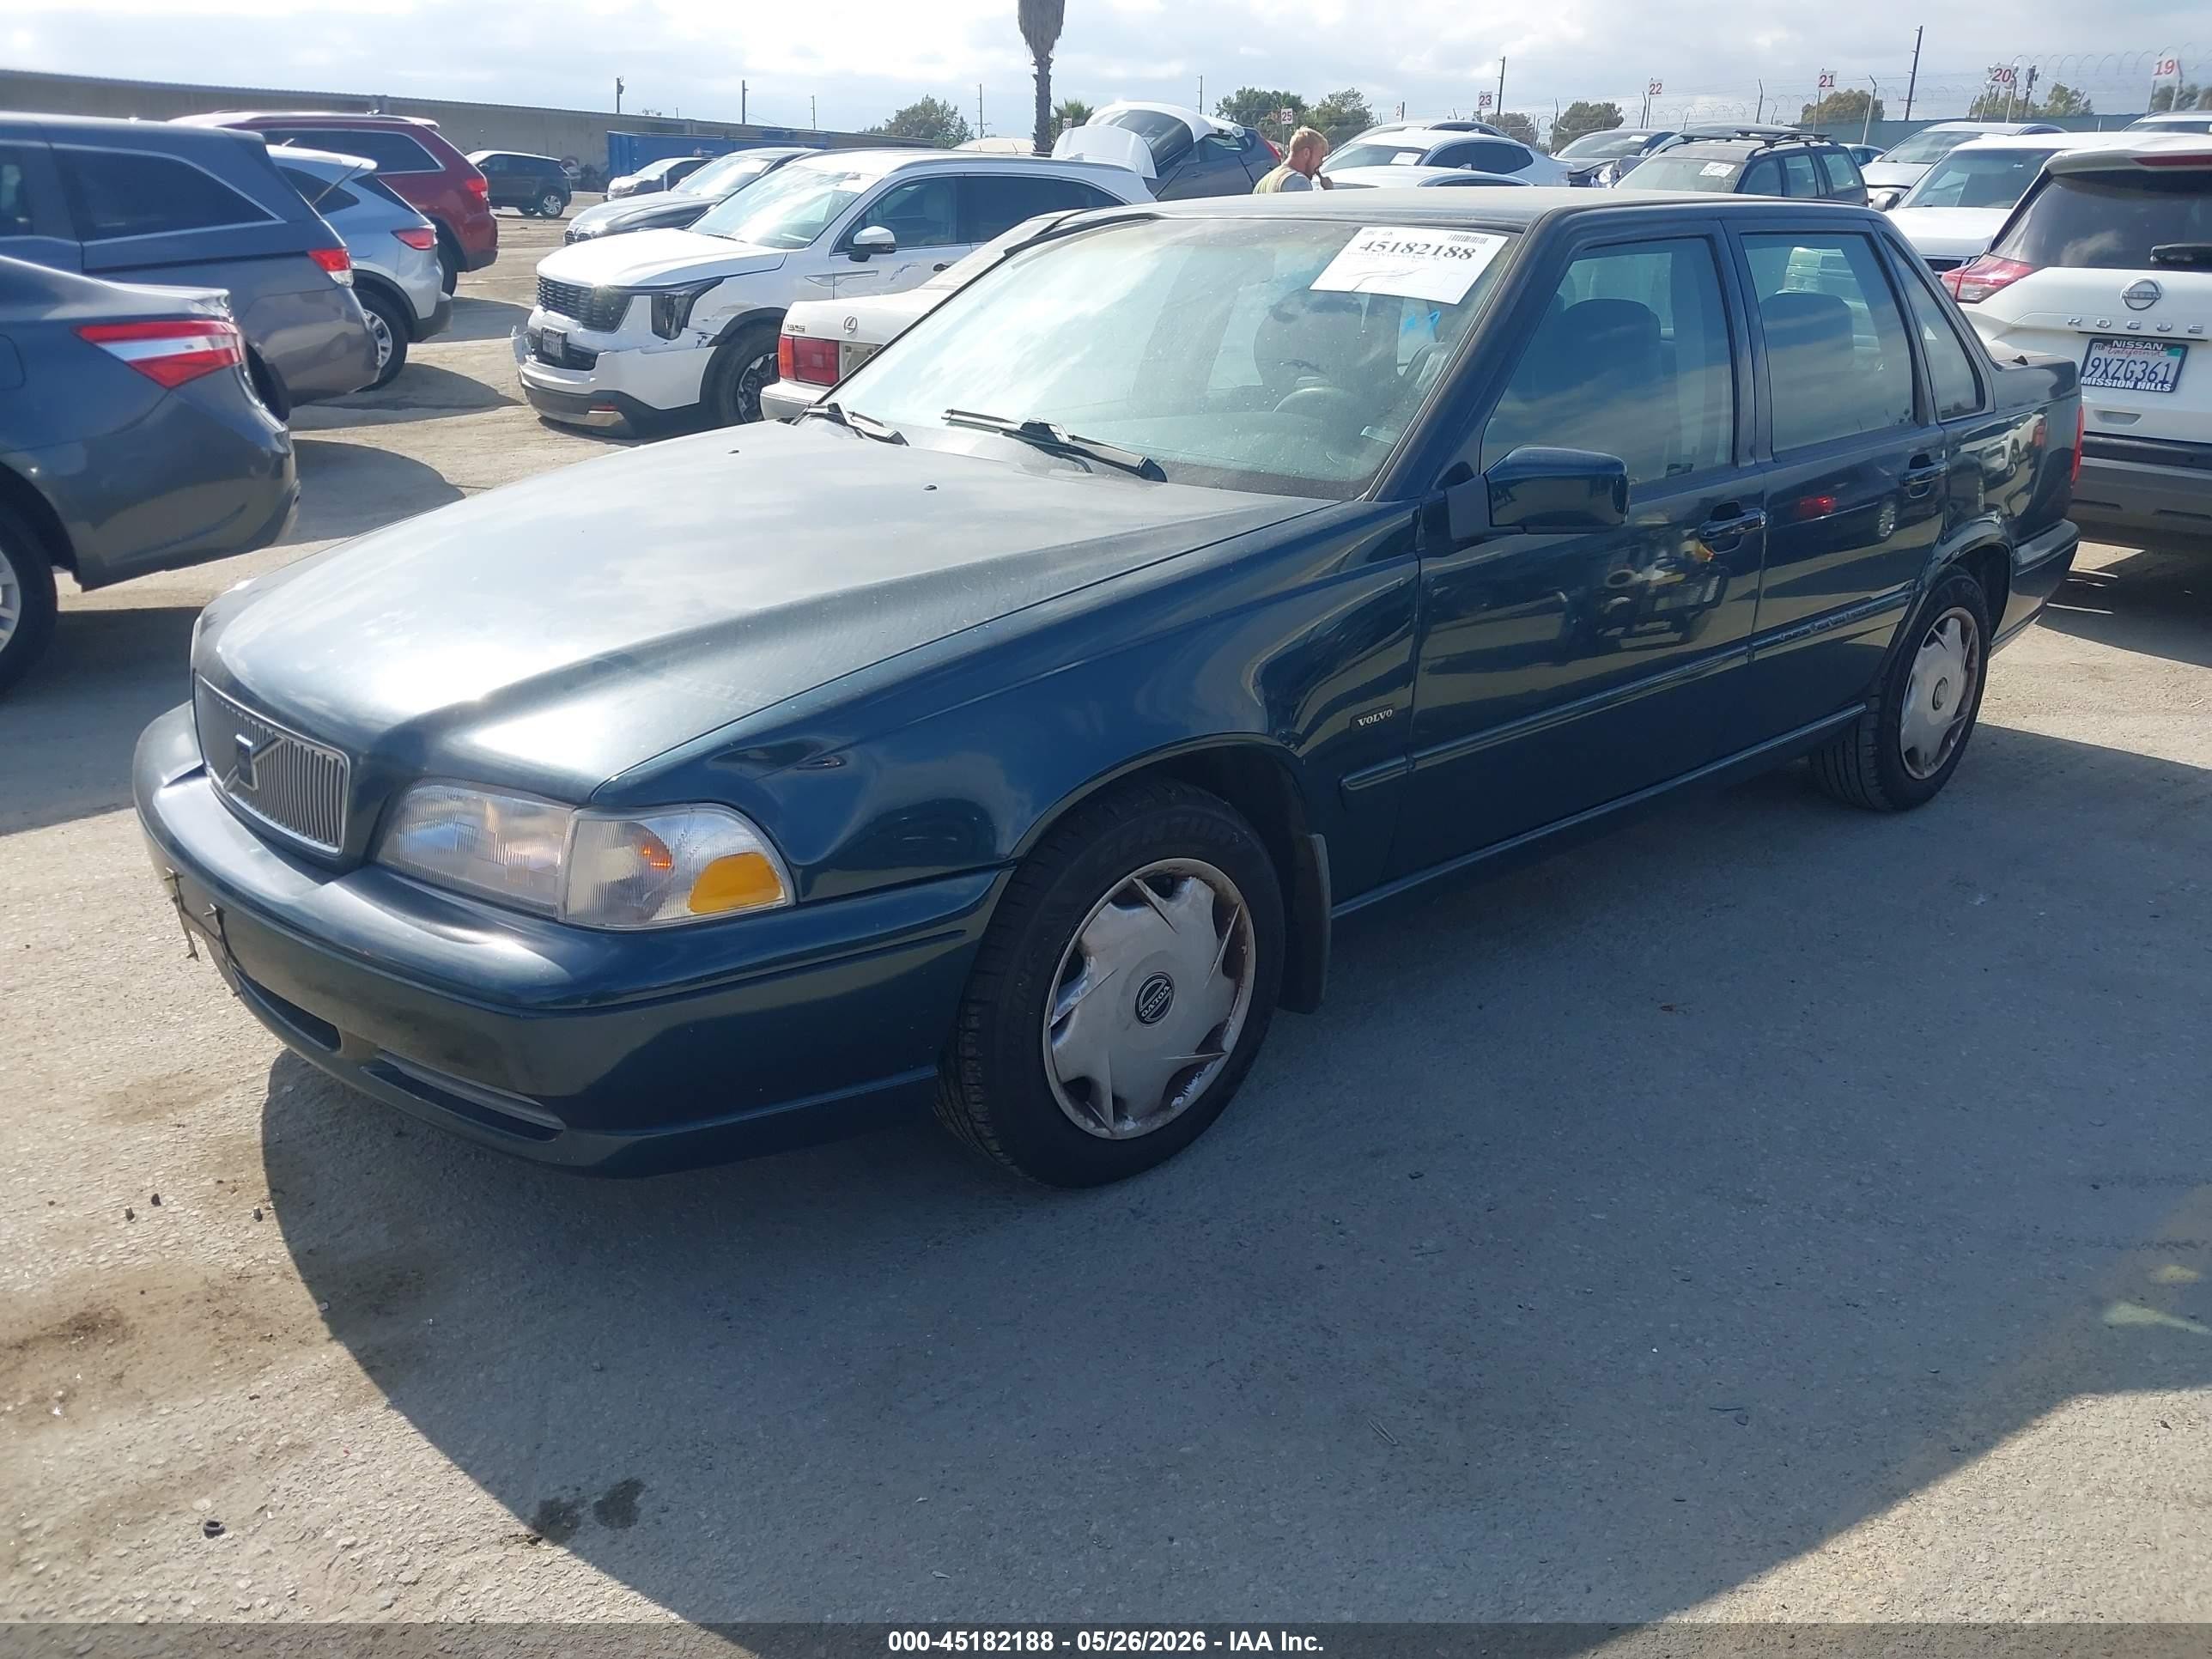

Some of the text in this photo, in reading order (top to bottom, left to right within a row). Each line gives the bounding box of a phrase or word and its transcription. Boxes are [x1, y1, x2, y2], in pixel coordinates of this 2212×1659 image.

[1992, 68, 2012, 82] 20
[2154, 59, 2175, 76] 19
[1649, 82, 1662, 95] 22
[1819, 74, 1835, 88] 21
[1479, 94, 1492, 106] 23
[1281, 111, 1292, 122] 25
[1359, 240, 1477, 261] 45182188
[2067, 315, 2204, 334] ROGUE
[2112, 339, 2163, 351] NISSAN
[2084, 356, 2172, 385] 9XZG361
[2080, 376, 2172, 392] MISSION HILLS
[1357, 708, 1393, 726] VOLVO
[1141, 985, 1170, 1018] VOLVO
